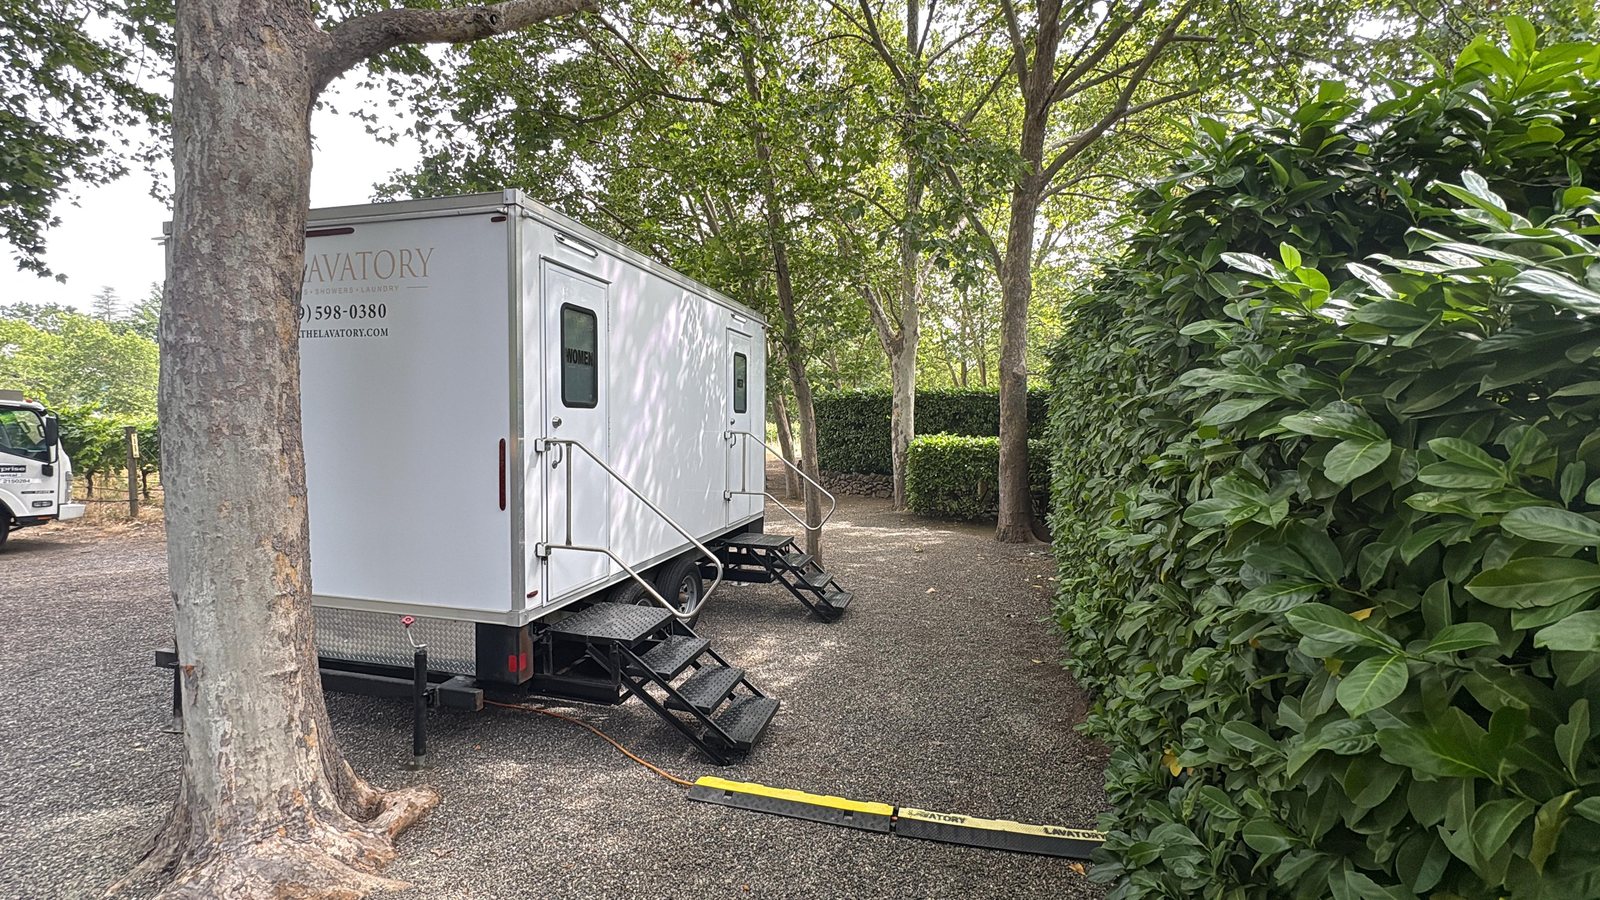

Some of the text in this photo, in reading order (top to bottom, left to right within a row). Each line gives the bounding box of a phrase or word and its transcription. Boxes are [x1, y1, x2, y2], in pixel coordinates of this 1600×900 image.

[304, 247, 434, 283] AVATORY
[315, 287, 353, 295] SHOWERS
[361, 285, 399, 293] LAUNDRY
[566, 348, 593, 367] WOMEN
